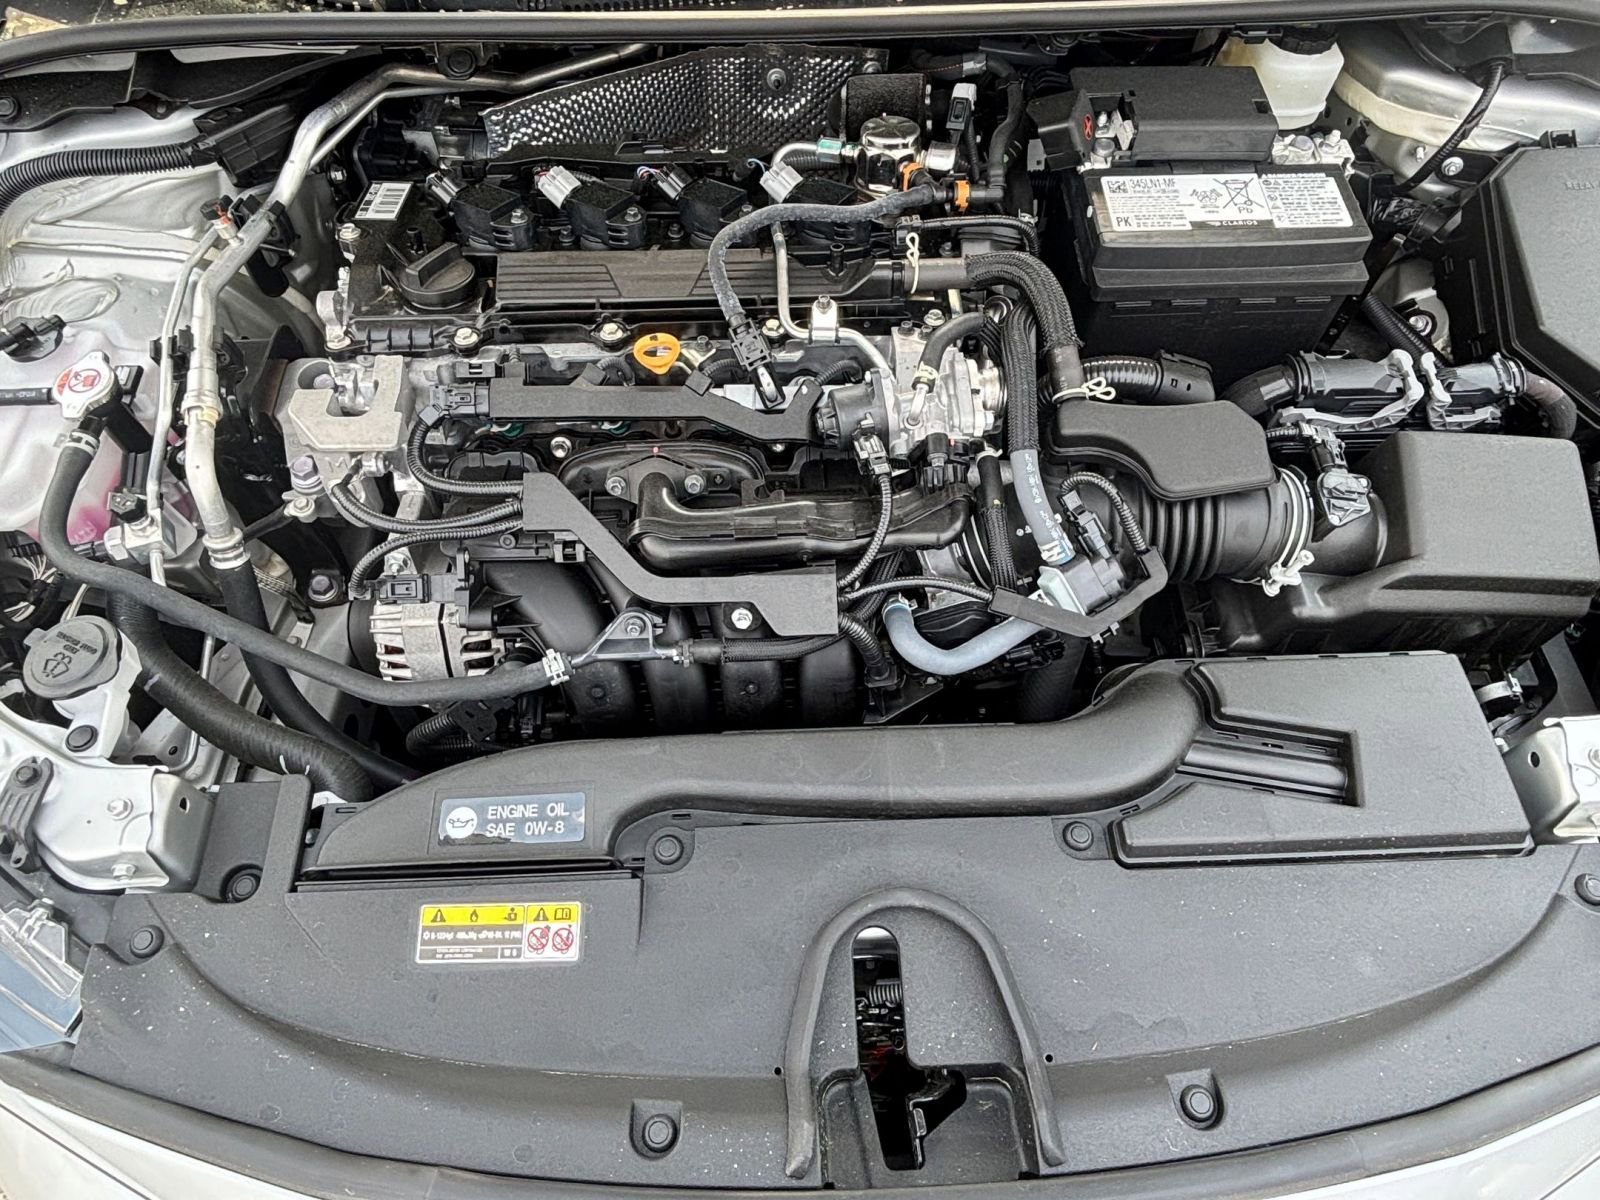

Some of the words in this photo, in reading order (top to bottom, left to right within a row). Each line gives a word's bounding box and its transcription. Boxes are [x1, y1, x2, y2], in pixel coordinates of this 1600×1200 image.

[1115, 216, 1132, 228] PK
[487, 804, 538, 820] ENGINE
[546, 802, 570, 817] OIL
[485, 822, 515, 837] SAE
[524, 820, 564, 836] 0W-8
